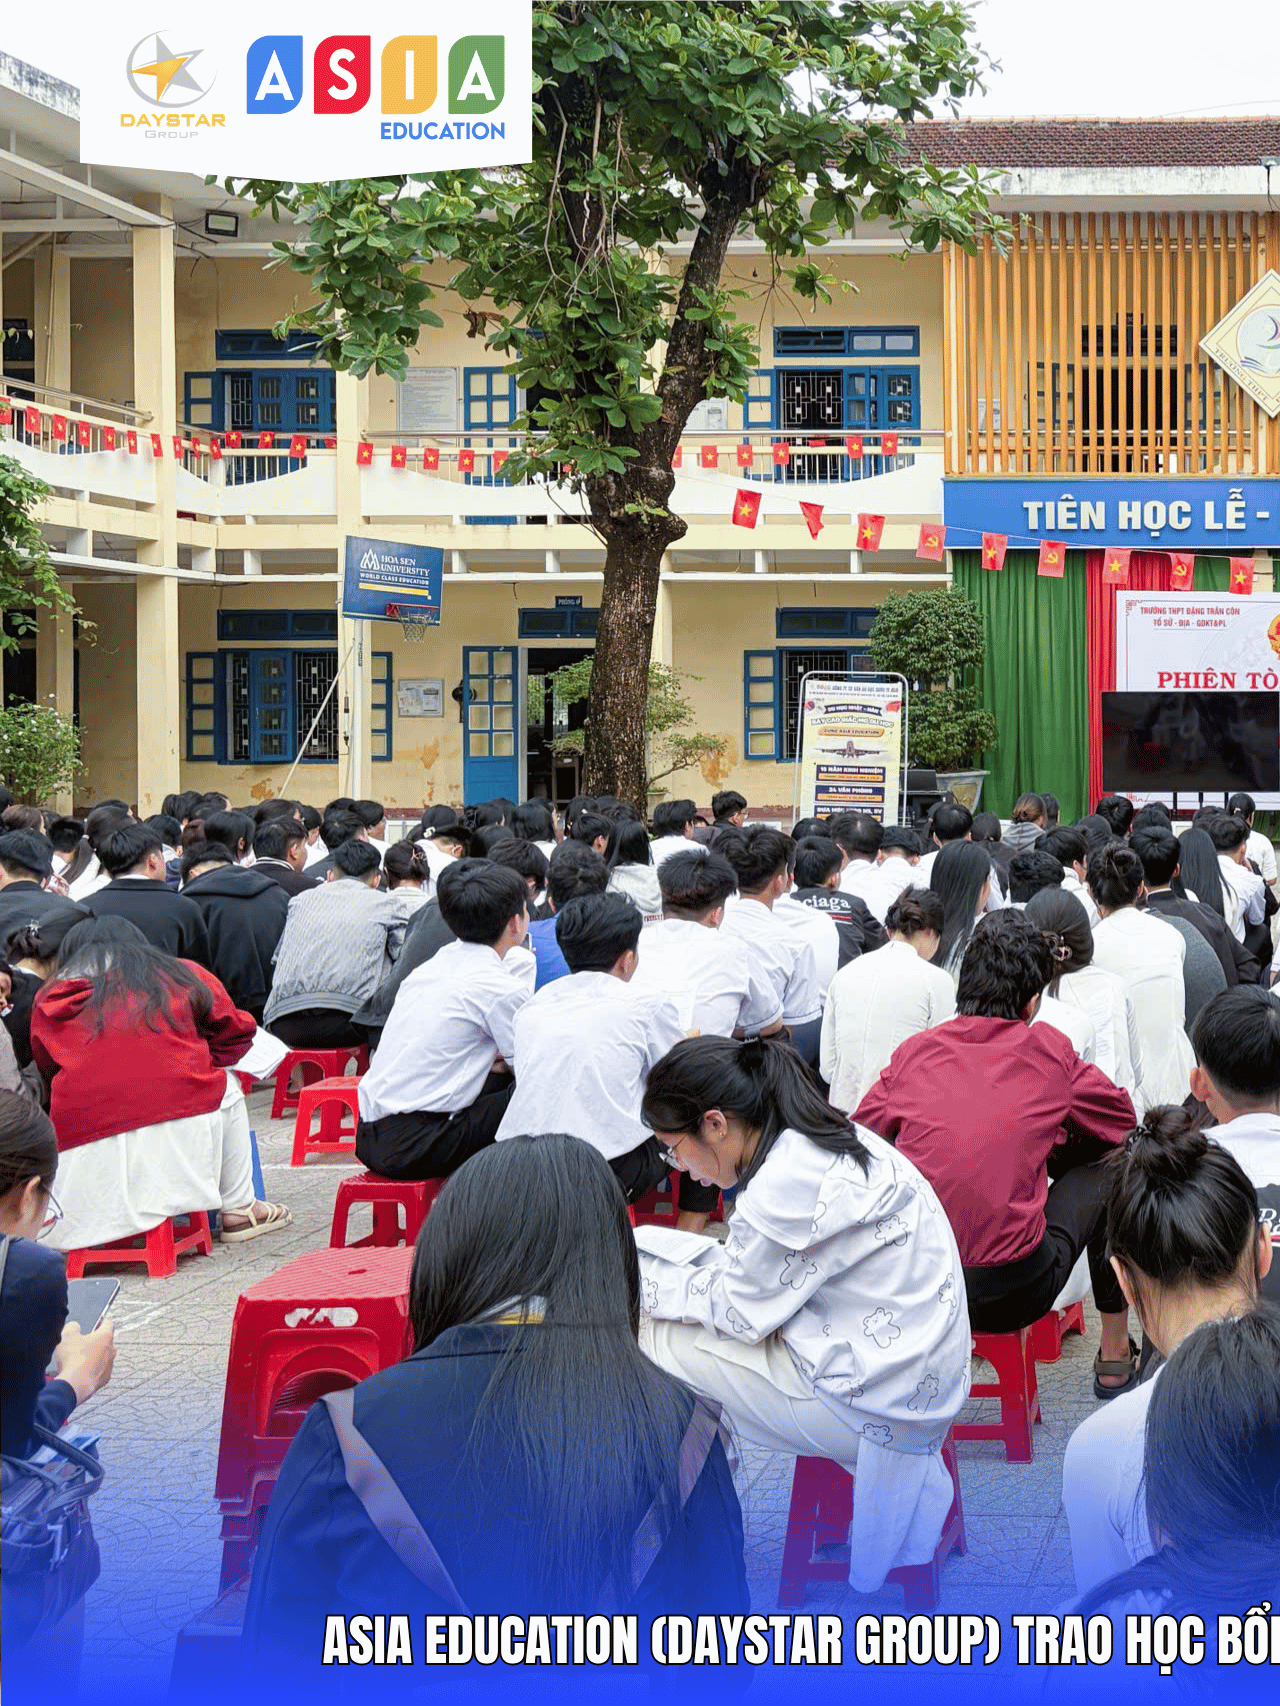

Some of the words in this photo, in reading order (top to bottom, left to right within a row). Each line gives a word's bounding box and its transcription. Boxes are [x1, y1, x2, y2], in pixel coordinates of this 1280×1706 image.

[1247, 380, 1269, 402] THPT
[1023, 493, 1106, 530] TIÊN
[1118, 500, 1192, 537] HỌC
[1205, 488, 1246, 530] LỄ
[1256, 511, 1270, 519] -
[381, 555, 398, 564] HOA
[400, 557, 416, 566] SEN
[360, 572, 380, 580] WORLD
[381, 574, 398, 582] CLASS
[399, 576, 429, 585] EDUCATION
[380, 564, 430, 576] UNIVERSITY
[1157, 667, 1238, 690] PHIÊN
[802, 894, 852, 911] ciaga
